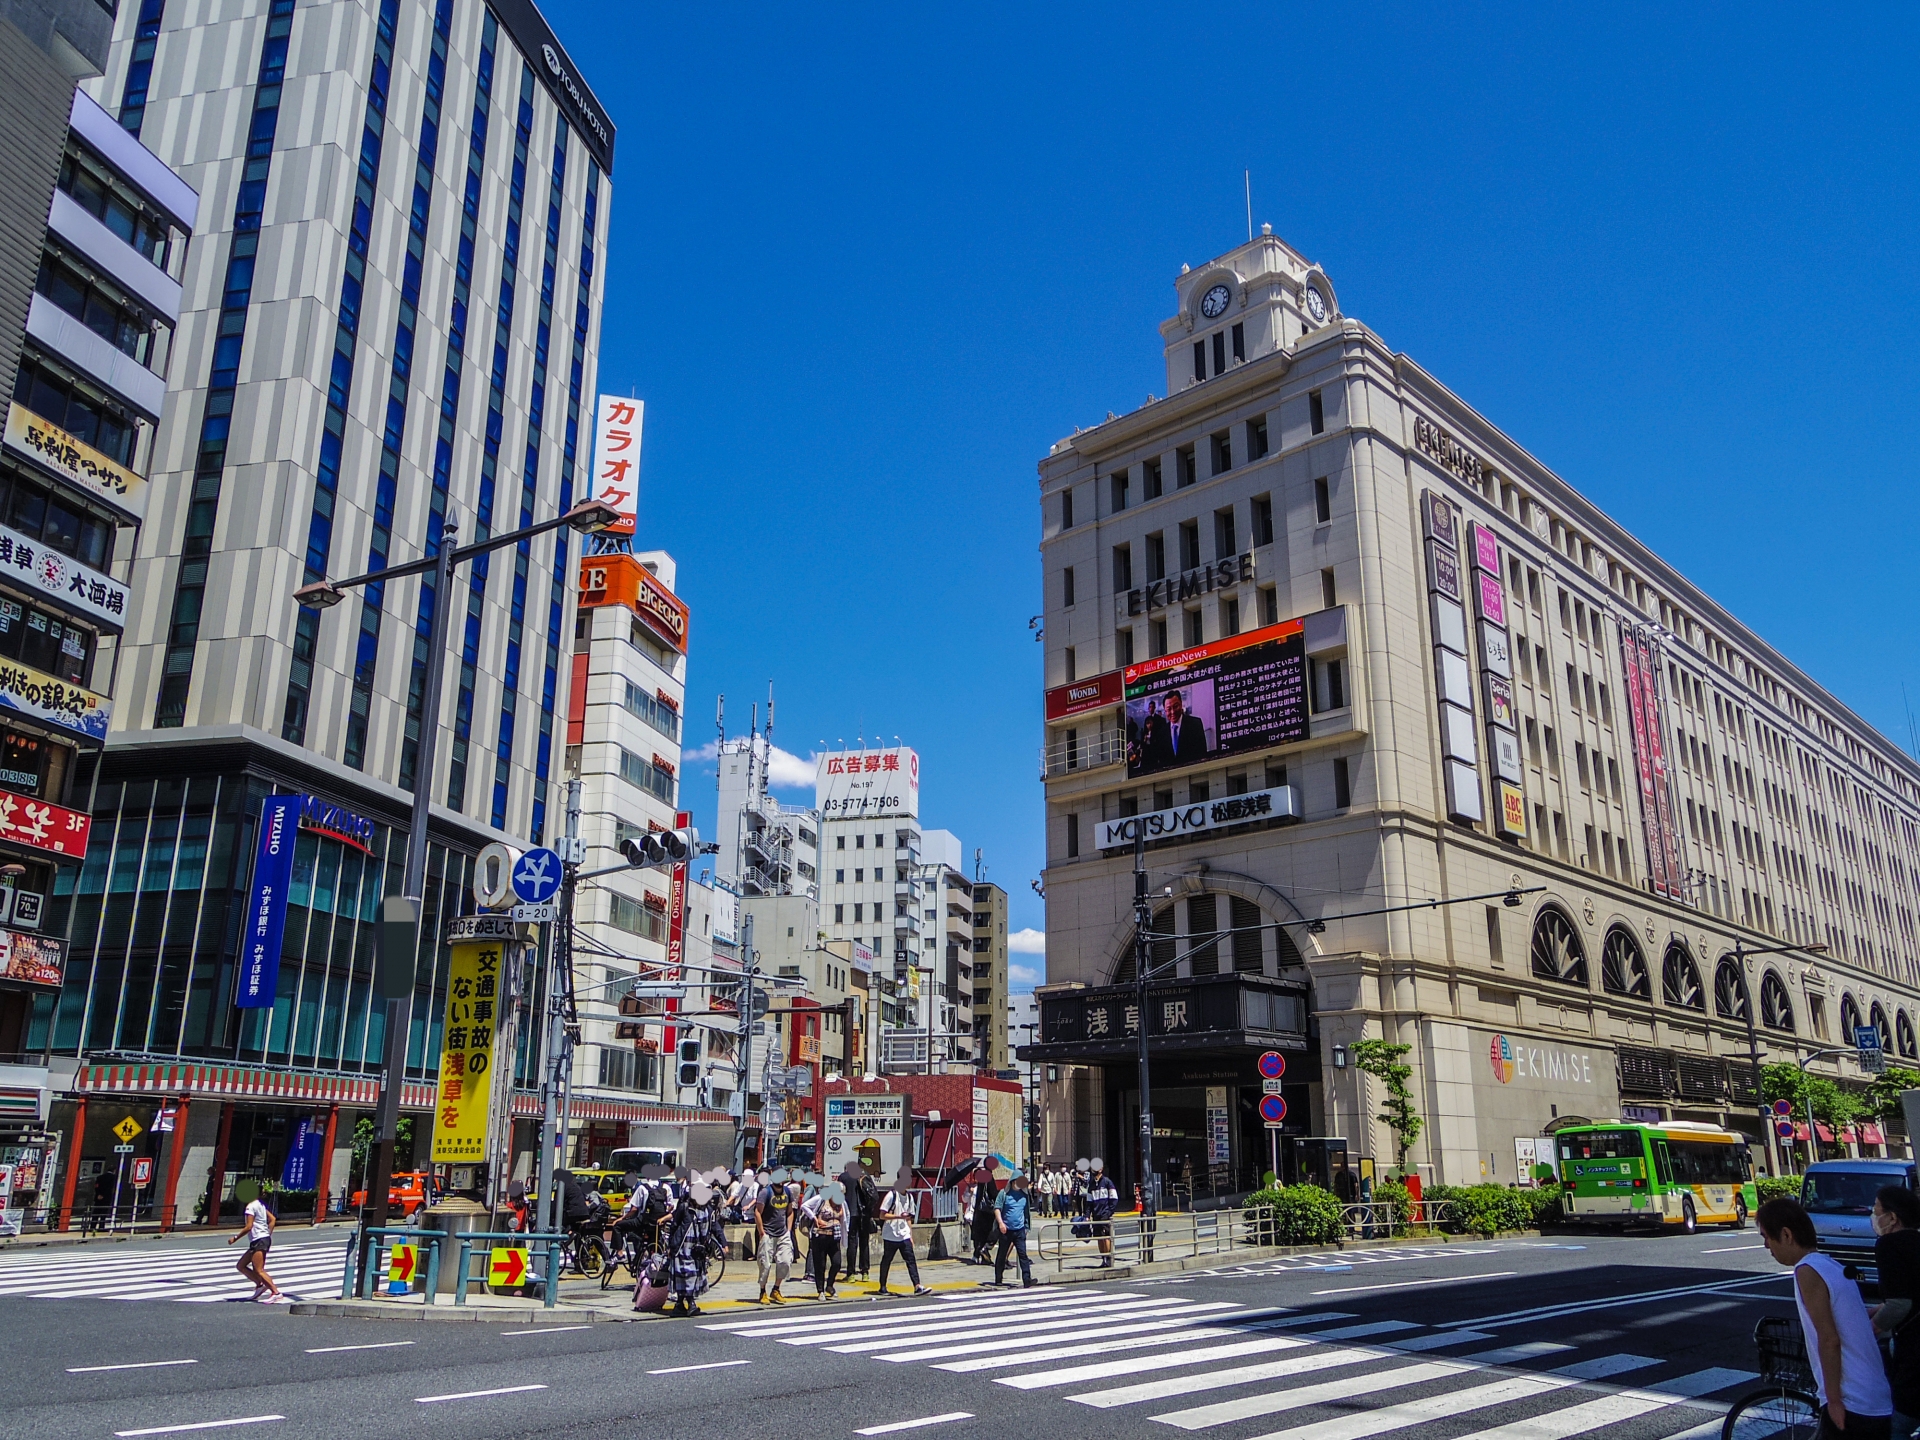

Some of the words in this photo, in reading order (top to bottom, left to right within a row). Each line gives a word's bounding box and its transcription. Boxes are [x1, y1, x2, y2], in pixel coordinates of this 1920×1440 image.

[560, 66, 584, 108] TOBU
[583, 103, 608, 146] HOTEL
[600, 401, 636, 509] カラオケ
[68, 572, 124, 615] 大酒場
[1127, 552, 1255, 617] EKIMISE
[637, 580, 658, 609] BIG
[658, 600, 684, 636] ECHO
[1068, 686, 1098, 700] WONDA
[1492, 680, 1510, 700] Seria
[827, 753, 900, 775] 広告募集
[851, 780, 874, 789] No.197
[300, 792, 375, 839] MIZUHO
[824, 796, 900, 810] 03-5774-7506
[1505, 792, 1522, 814] ABC
[1505, 810, 1522, 826] MART
[66, 814, 86, 832] 3F
[270, 806, 286, 855] MIZUHO
[256, 886, 272, 936] みずほ銀行
[517, 908, 548, 918] 8-20
[248, 944, 264, 996] みずほ証券
[468, 950, 498, 1074] 交通事故の
[1086, 1000, 1188, 1035] 浅草駅
[441, 976, 473, 1128] ない街浅草を
[1516, 1046, 1592, 1083] EKIMISE
[1182, 1072, 1210, 1080] Asakusa
[1212, 1070, 1238, 1078] Station
[298, 1122, 307, 1150] MIZUHO
[436, 1146, 482, 1154] 浅草交通安全協会
